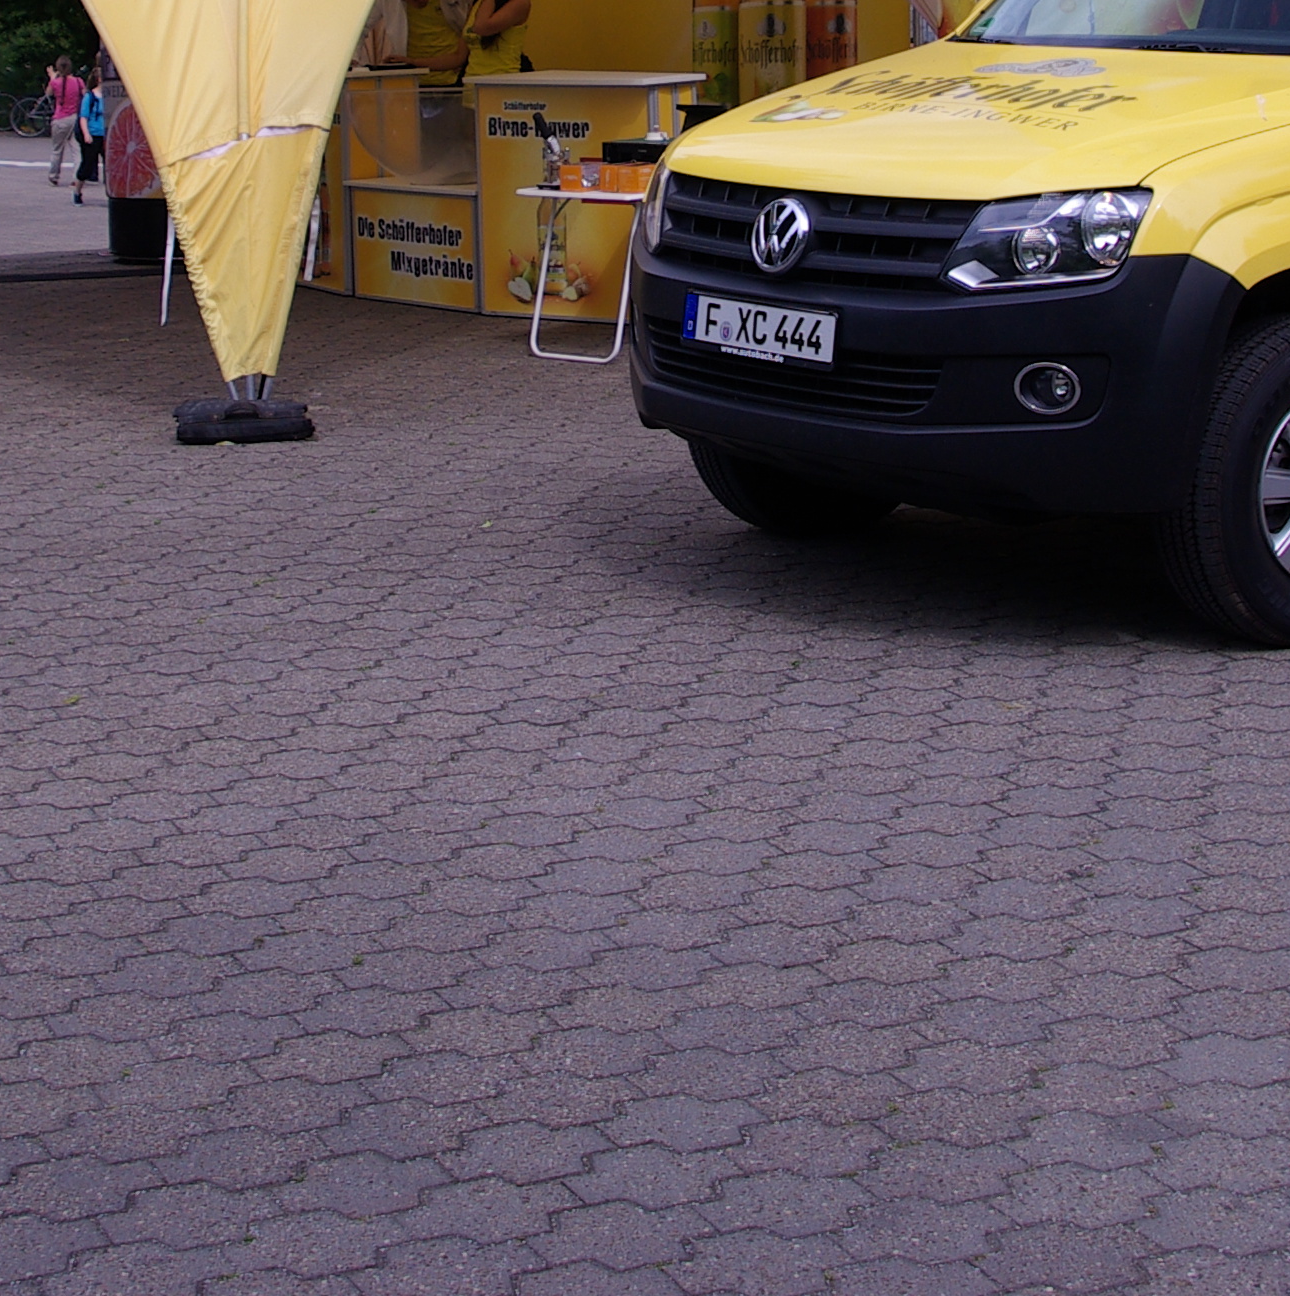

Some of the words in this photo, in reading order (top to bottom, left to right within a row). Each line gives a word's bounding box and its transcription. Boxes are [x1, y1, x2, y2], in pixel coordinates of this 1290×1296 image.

[784, 69, 1138, 112] Schöfferhofer
[852, 101, 1079, 131] BIRNE-INGWER
[357, 216, 376, 239] Die
[378, 217, 462, 248] Schöfferhofer
[391, 250, 474, 281] Mixgetränke
[705, 302, 721, 336] F
[735, 307, 767, 345] XC
[774, 314, 822, 356] 444
